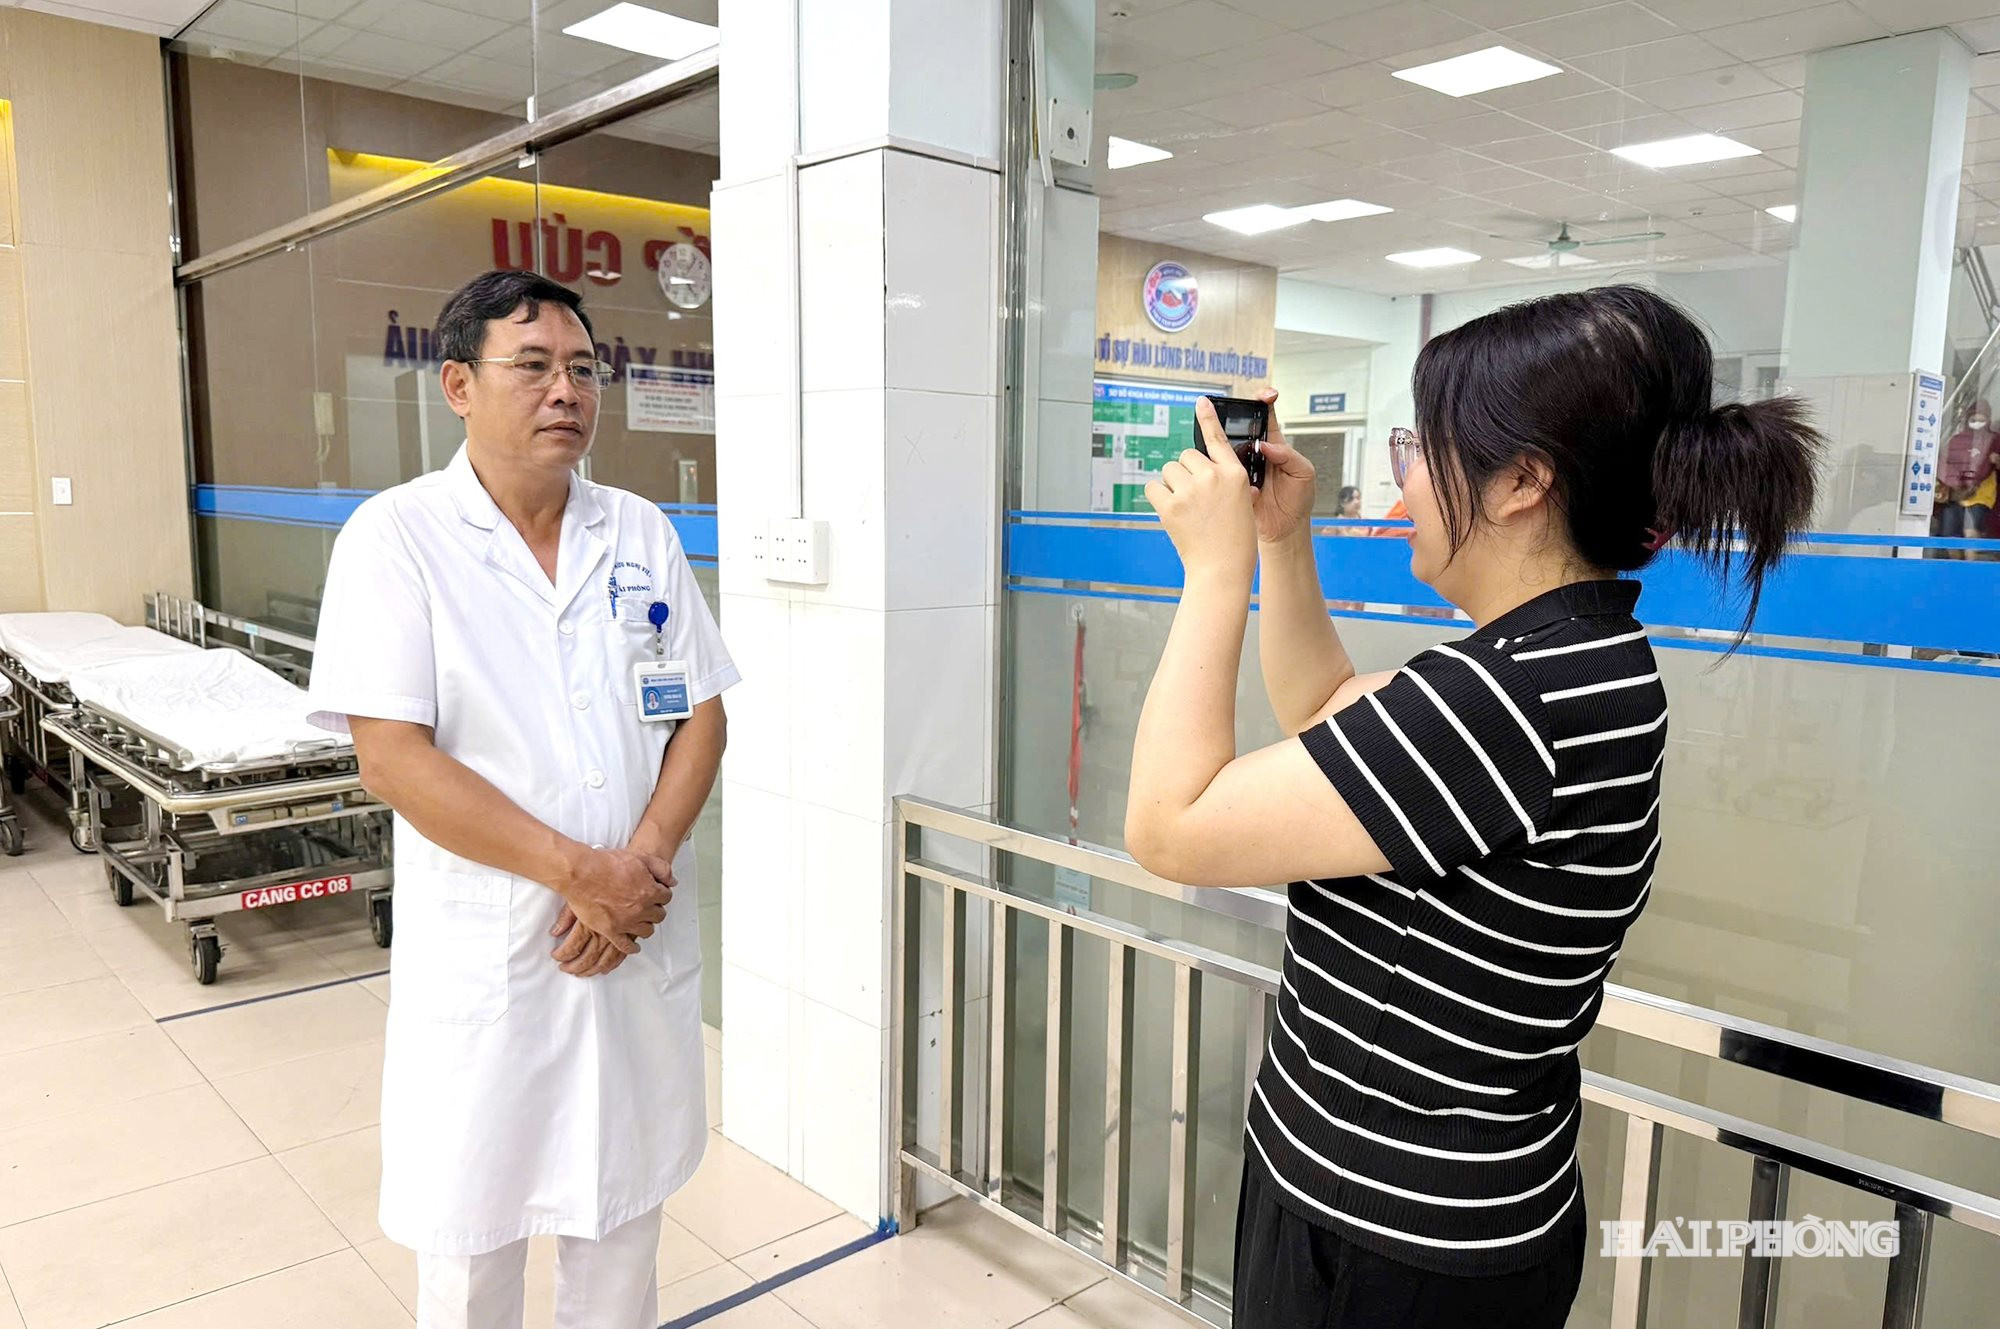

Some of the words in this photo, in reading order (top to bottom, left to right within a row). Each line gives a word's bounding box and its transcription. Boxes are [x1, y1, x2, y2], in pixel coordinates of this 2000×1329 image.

[245, 887, 297, 909] CÁNG
[300, 882, 325, 899] CC
[328, 878, 348, 894] 08
